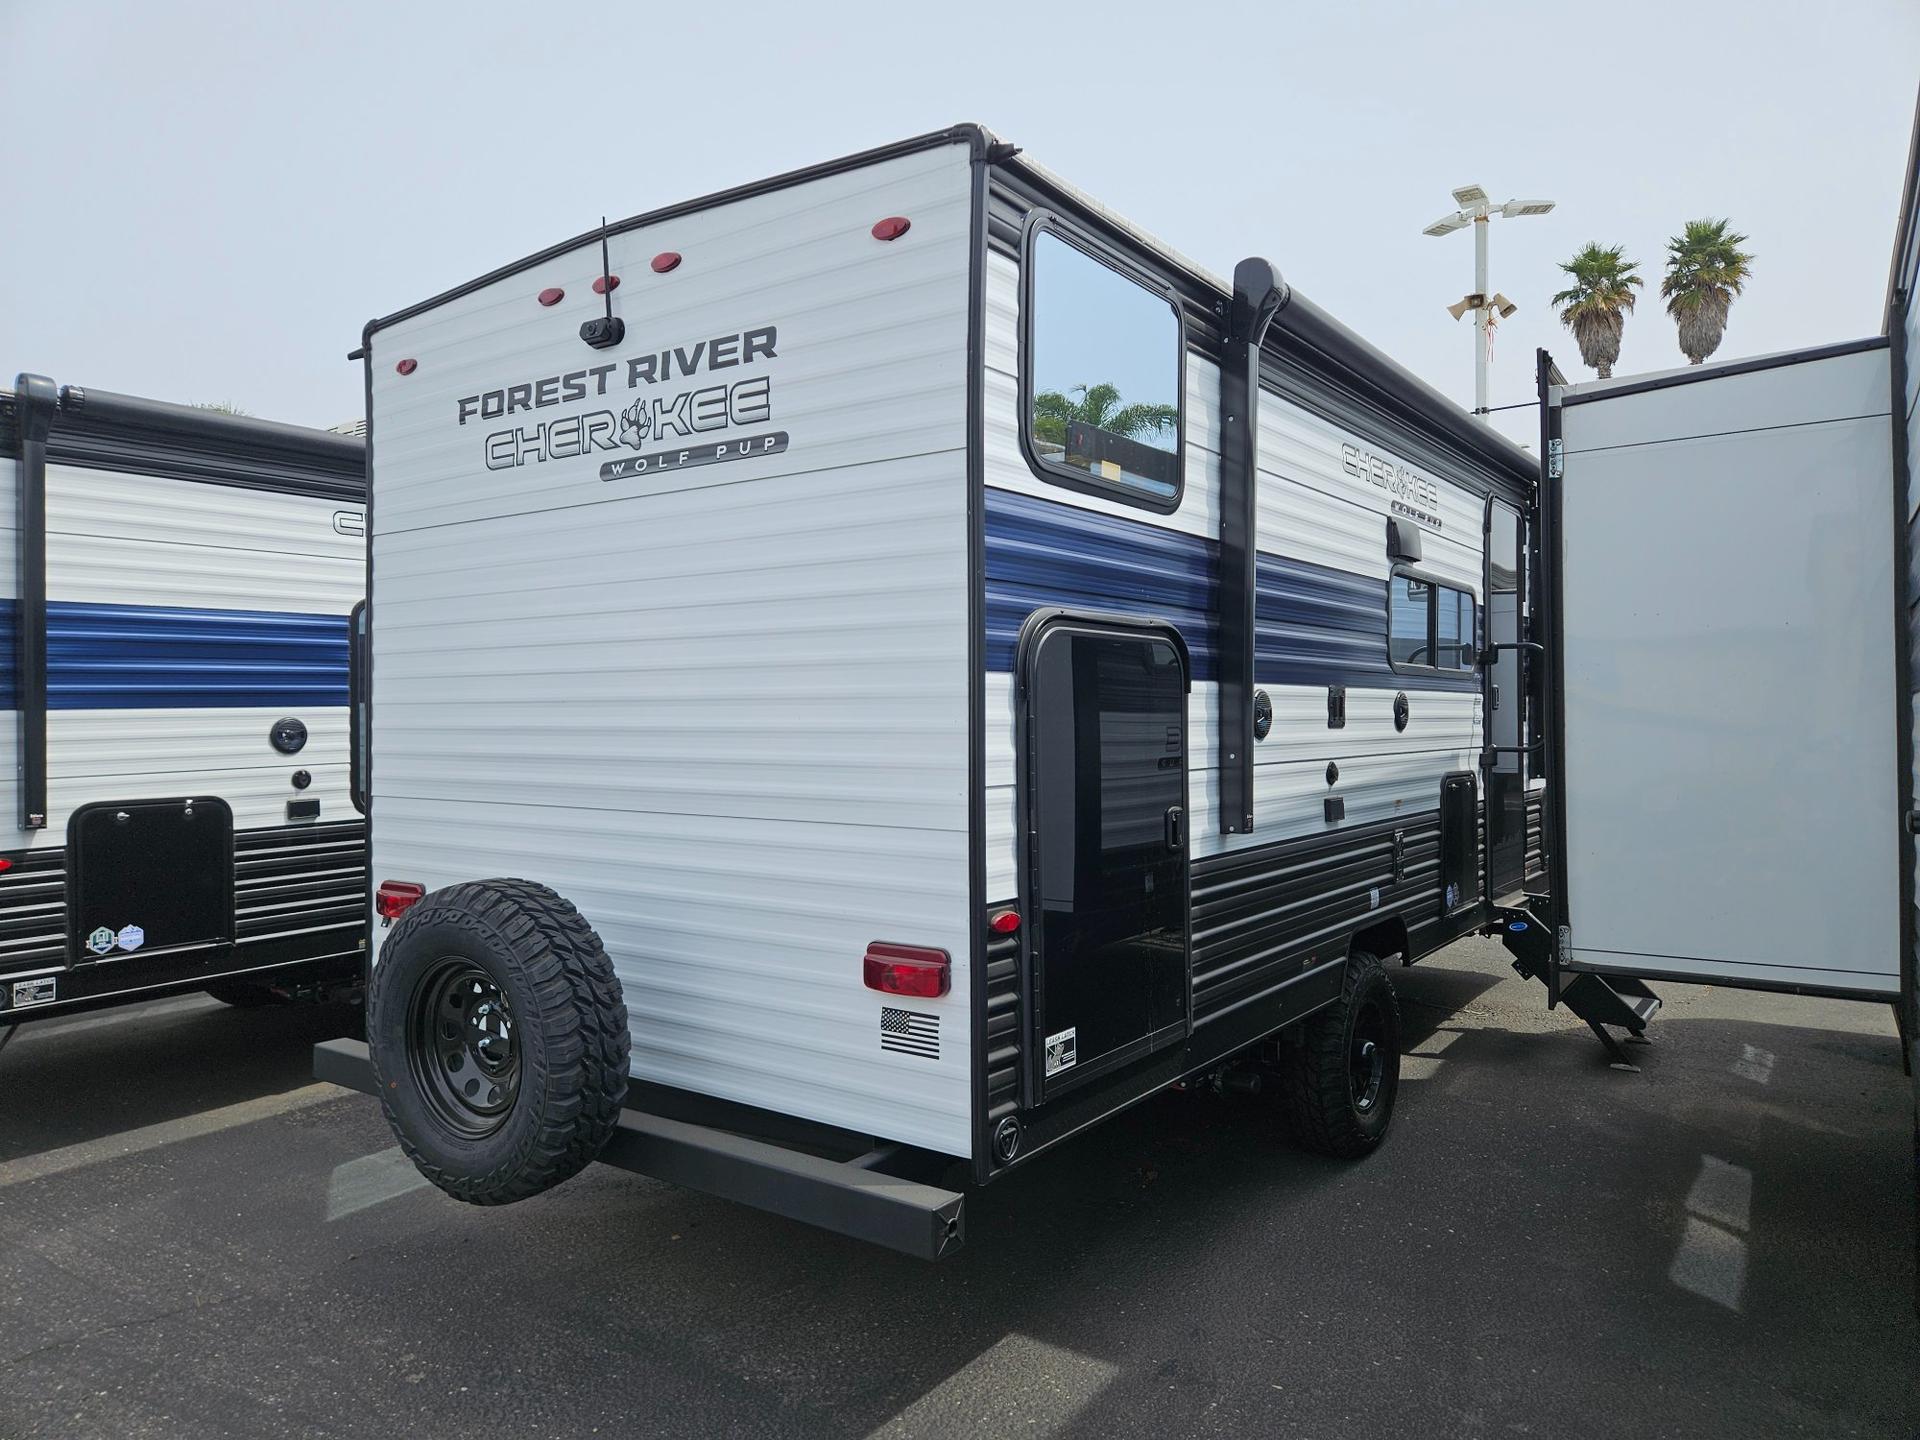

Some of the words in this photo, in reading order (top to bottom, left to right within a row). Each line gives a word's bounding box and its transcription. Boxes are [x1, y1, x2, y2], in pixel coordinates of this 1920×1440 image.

[457, 363, 617, 425] FOREST
[626, 326, 778, 389] RIVER
[611, 451, 689, 476] WOLF
[716, 437, 776, 460] PUP
